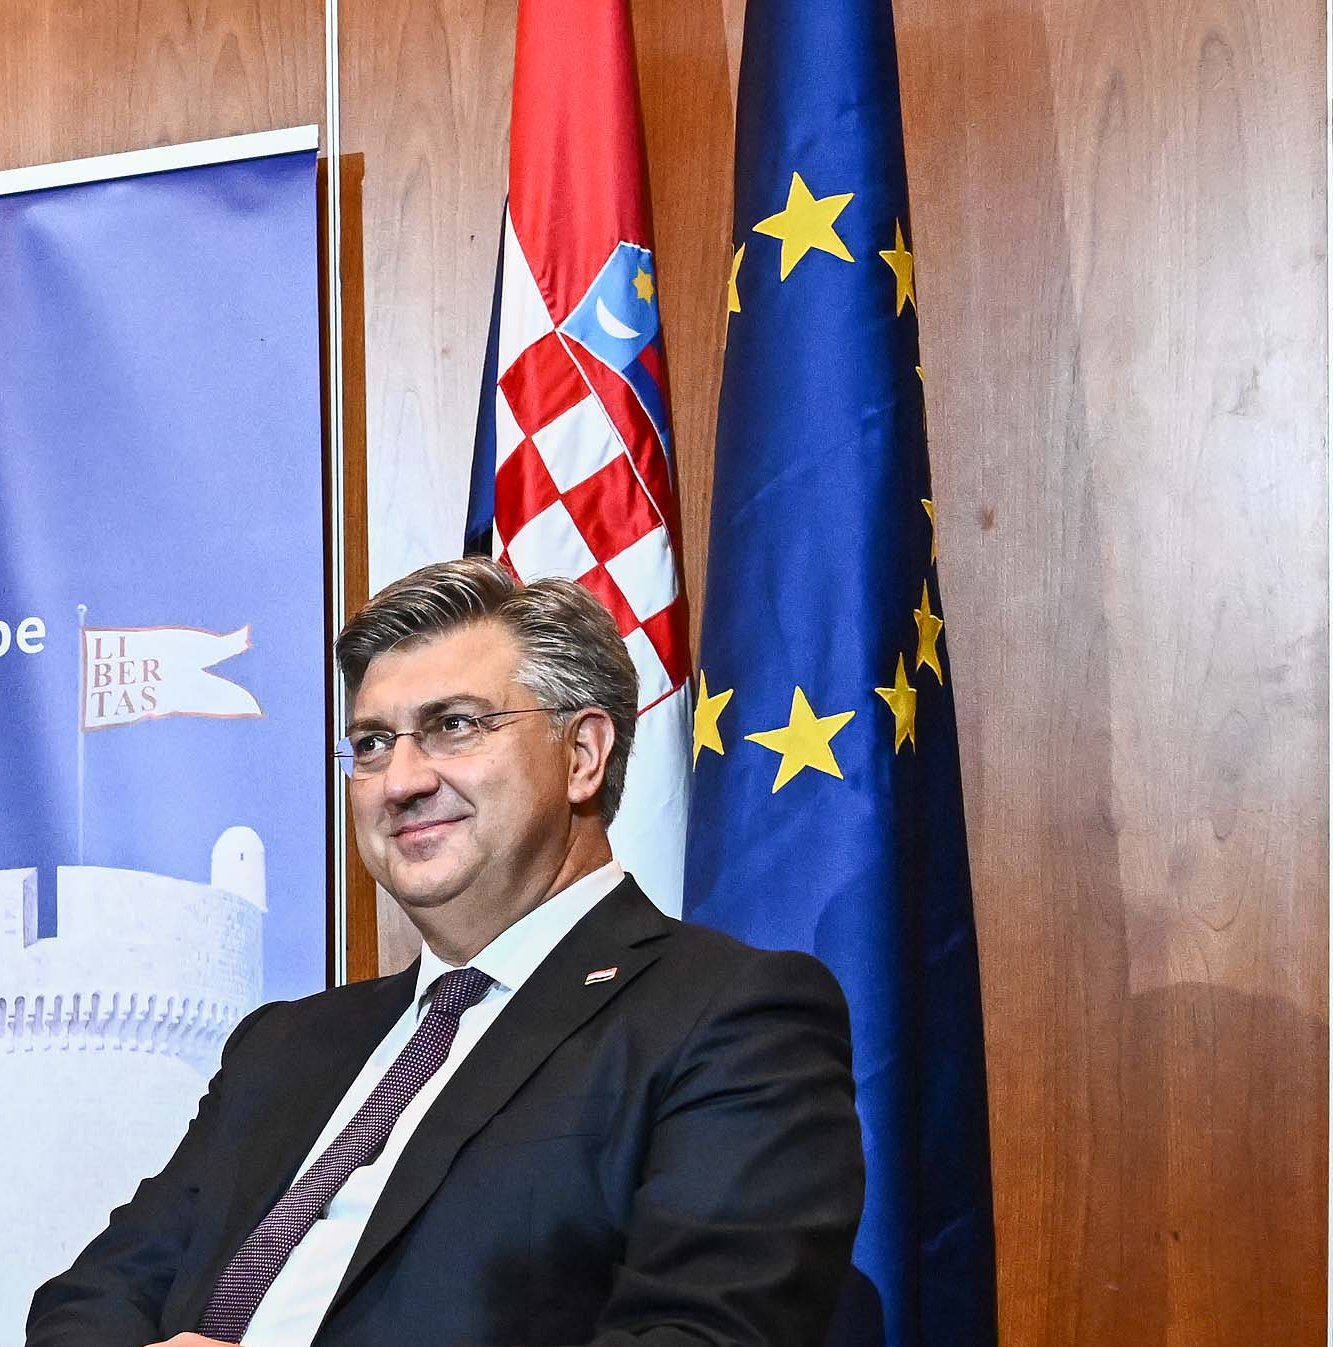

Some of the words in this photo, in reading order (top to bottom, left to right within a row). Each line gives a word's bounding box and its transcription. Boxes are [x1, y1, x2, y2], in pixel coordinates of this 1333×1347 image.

[94, 636, 126, 659] LI
[93, 659, 162, 688] BER
[91, 686, 158, 718] TAS
